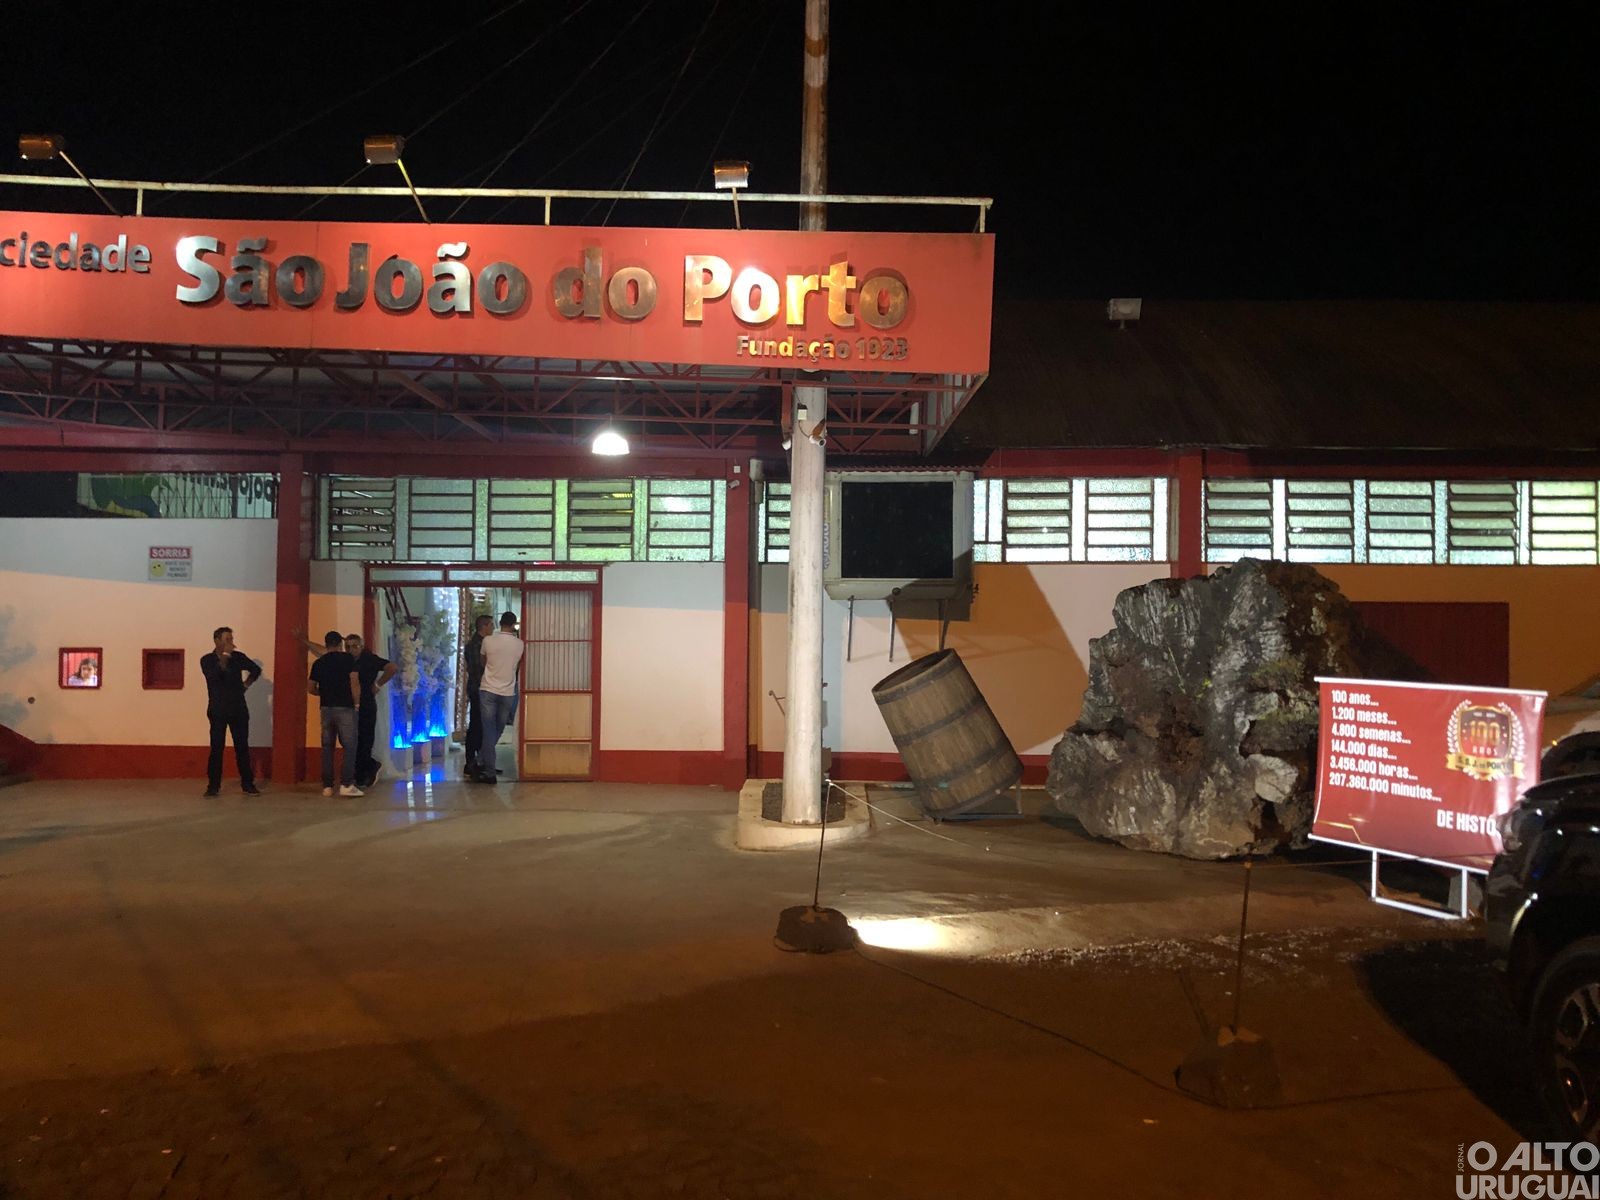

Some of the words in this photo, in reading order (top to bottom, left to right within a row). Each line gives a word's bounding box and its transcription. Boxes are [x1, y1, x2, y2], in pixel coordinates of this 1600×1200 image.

[175, 235, 324, 306] São
[336, 242, 528, 315] João
[554, 246, 656, 319] do
[685, 255, 909, 329] Porto
[737, 335, 850, 363] Fundação
[856, 337, 908, 361] 1923
[152, 549, 188, 558] SORRIA
[1332, 690, 1347, 703] 100
[1349, 693, 1379, 706] anos...
[1332, 706, 1355, 720] 1.200
[1357, 710, 1397, 725] meses...
[1332, 722, 1357, 737] 4.800
[1331, 739, 1366, 756] 144.000
[1368, 744, 1397, 760] dias...
[1379, 762, 1418, 780] horas...
[1391, 782, 1442, 802] minutos...
[1437, 809, 1454, 829] DE
